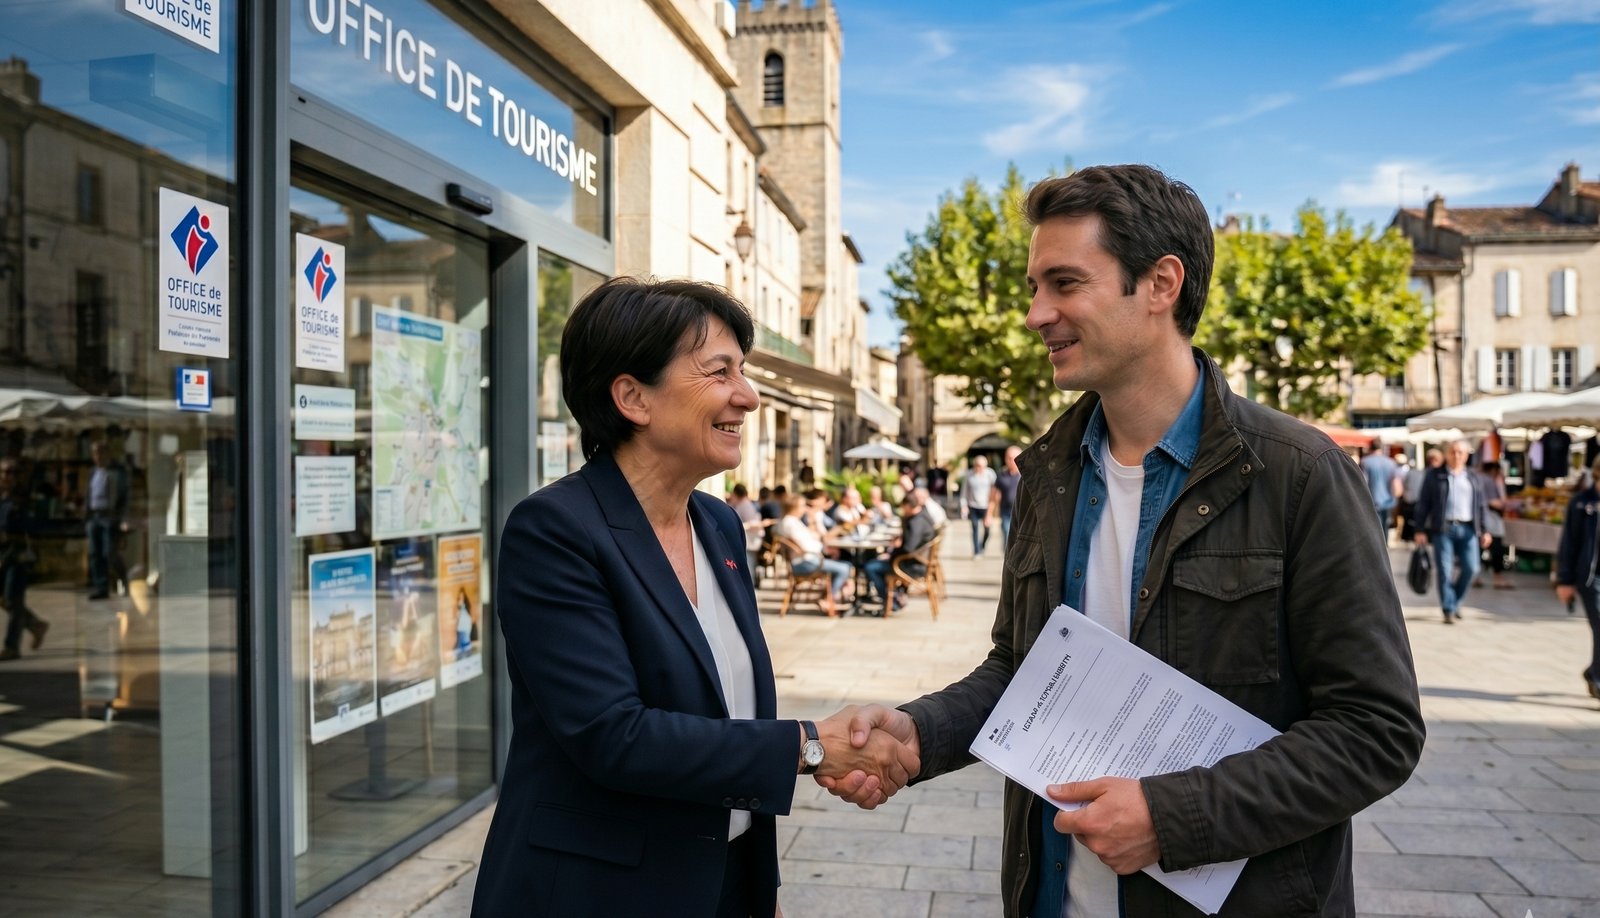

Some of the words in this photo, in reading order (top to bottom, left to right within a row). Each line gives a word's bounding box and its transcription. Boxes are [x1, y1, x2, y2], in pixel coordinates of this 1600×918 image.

[309, 0, 437, 99] OFFICE
[446, 59, 483, 127] DE
[488, 86, 597, 196] TOURISME
[168, 277, 206, 297] OFFICE
[209, 286, 221, 300] de
[168, 295, 222, 317] TOURISME
[301, 306, 328, 322] OFFICE
[330, 313, 339, 324] de
[302, 320, 339, 338] TOURISME
